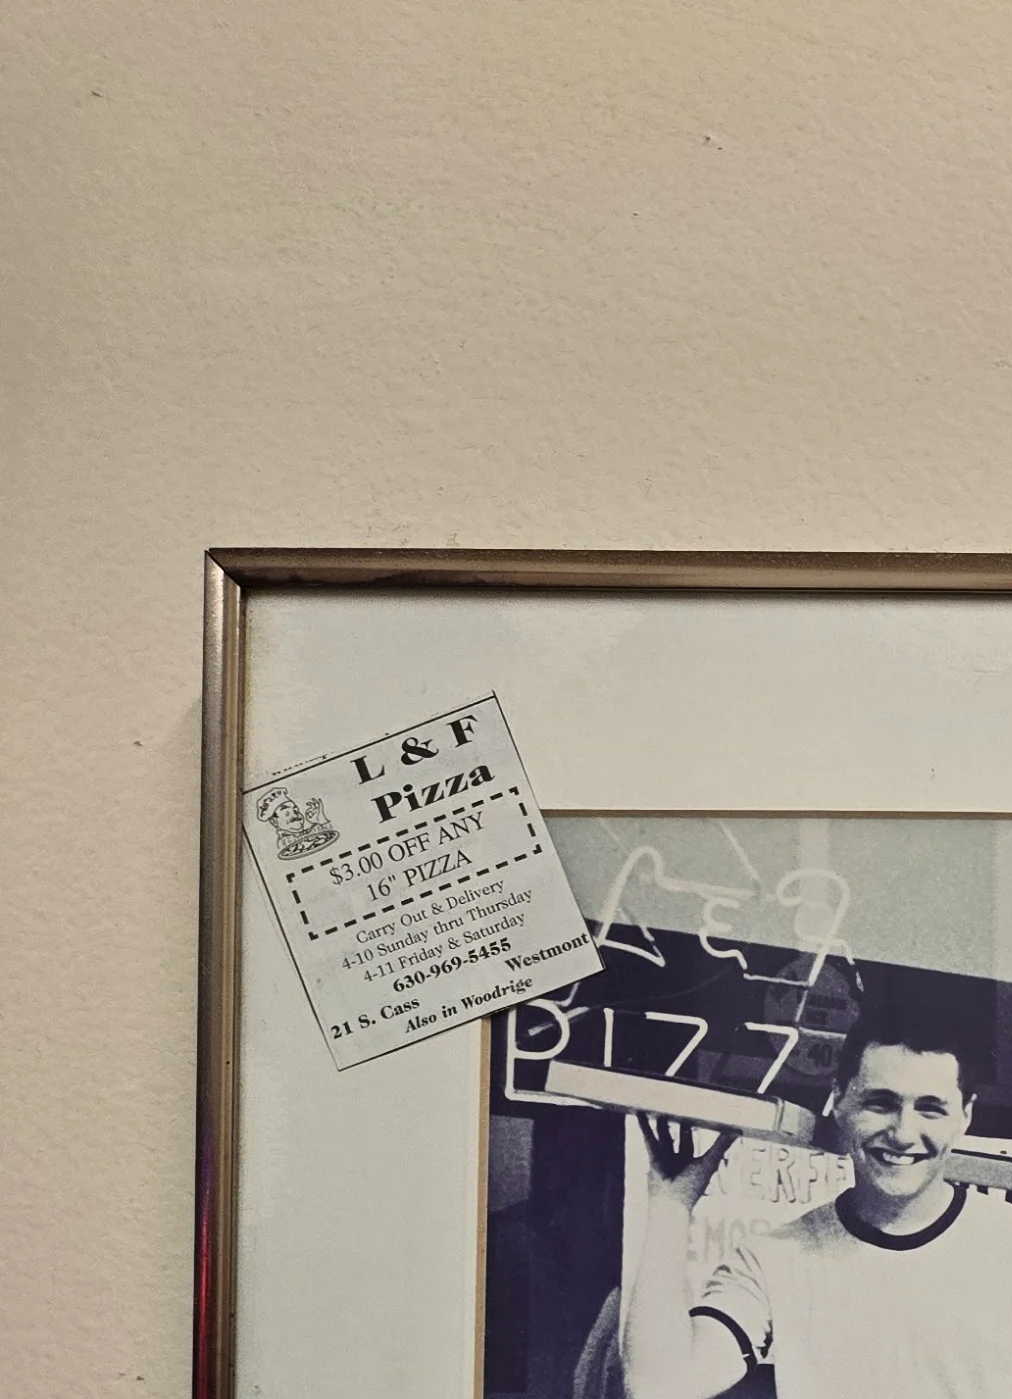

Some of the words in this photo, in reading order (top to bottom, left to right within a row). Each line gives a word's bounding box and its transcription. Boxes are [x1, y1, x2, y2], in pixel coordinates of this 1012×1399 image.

[351, 755, 385, 785] L
[399, 736, 439, 767] &
[447, 714, 479, 748] F
[371, 764, 495, 824] Pizza
[329, 851, 384, 886] $3.00
[388, 833, 431, 864] OFF
[437, 811, 486, 847] ANY
[366, 876, 399, 902] 16"
[404, 851, 473, 888] PIZZA
[341, 947, 374, 971] 4-10
[377, 928, 430, 957] Sunday
[433, 913, 464, 936] thru
[466, 888, 533, 922] Thursday
[356, 915, 398, 945] Carry
[400, 908, 429, 928] Out
[431, 900, 445, 916] &
[447, 879, 505, 910] Delivery
[363, 960, 395, 984] 4-11
[397, 943, 444, 971] Friday
[447, 934, 462, 951] &
[463, 912, 526, 944] Saturday
[392, 937, 512, 993] 630-969-5455
[330, 1020, 353, 1040] 21
[358, 1011, 377, 1030] S.
[379, 997, 420, 1021] Cass
[504, 932, 590, 973] Westmont
[404, 1011, 437, 1034] Also
[441, 1004, 458, 1018] in
[461, 976, 533, 1011] Woodrige
